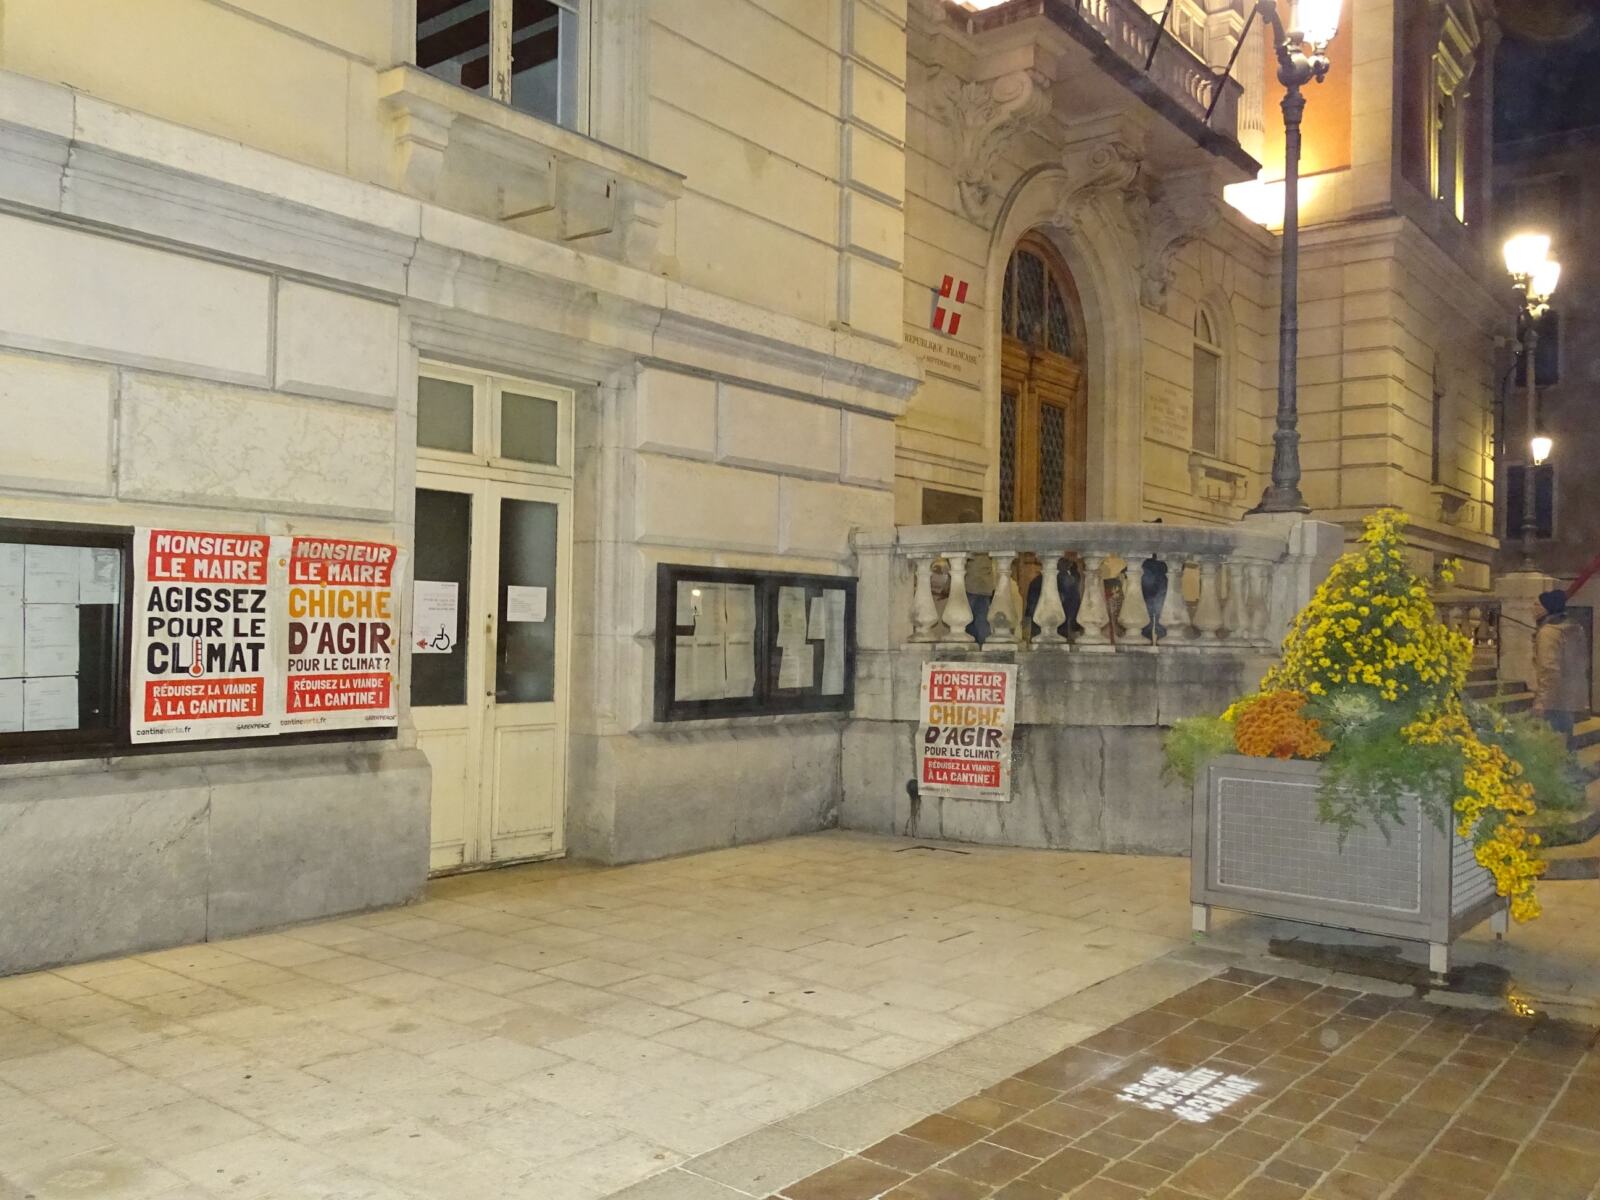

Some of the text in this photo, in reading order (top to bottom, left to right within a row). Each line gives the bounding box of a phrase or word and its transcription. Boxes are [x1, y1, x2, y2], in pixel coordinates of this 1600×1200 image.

[156, 534, 264, 557] MONSIEUR
[296, 541, 392, 563] MONSIEUR
[155, 556, 262, 580] LE MAIRE
[295, 561, 387, 583] LE MAIRE
[147, 586, 266, 613] AGISSEZ
[288, 588, 391, 619] CHICHE
[147, 616, 266, 638] POUR LE
[288, 621, 391, 655] D'AGIR
[288, 658, 320, 672] POUR
[323, 658, 338, 671] LE
[153, 683, 258, 697] RÉDUISEZ LA VIANDE
[293, 678, 384, 691] RÉDUISEZ LA VIANDE
[933, 673, 1002, 687] MONSIEUR
[293, 691, 302, 708] À
[305, 694, 320, 707] LA
[933, 686, 1002, 702] LE MAIRE
[152, 698, 162, 716] À
[166, 700, 186, 715] LA
[929, 704, 1005, 727] CHICHE
[925, 726, 1003, 748] D'AGIR
[925, 746, 947, 756] POUR
[950, 748, 961, 757] LE
[936, 771, 948, 782] LA
[962, 762, 970, 771] LA
[972, 764, 996, 773] VIANDE
